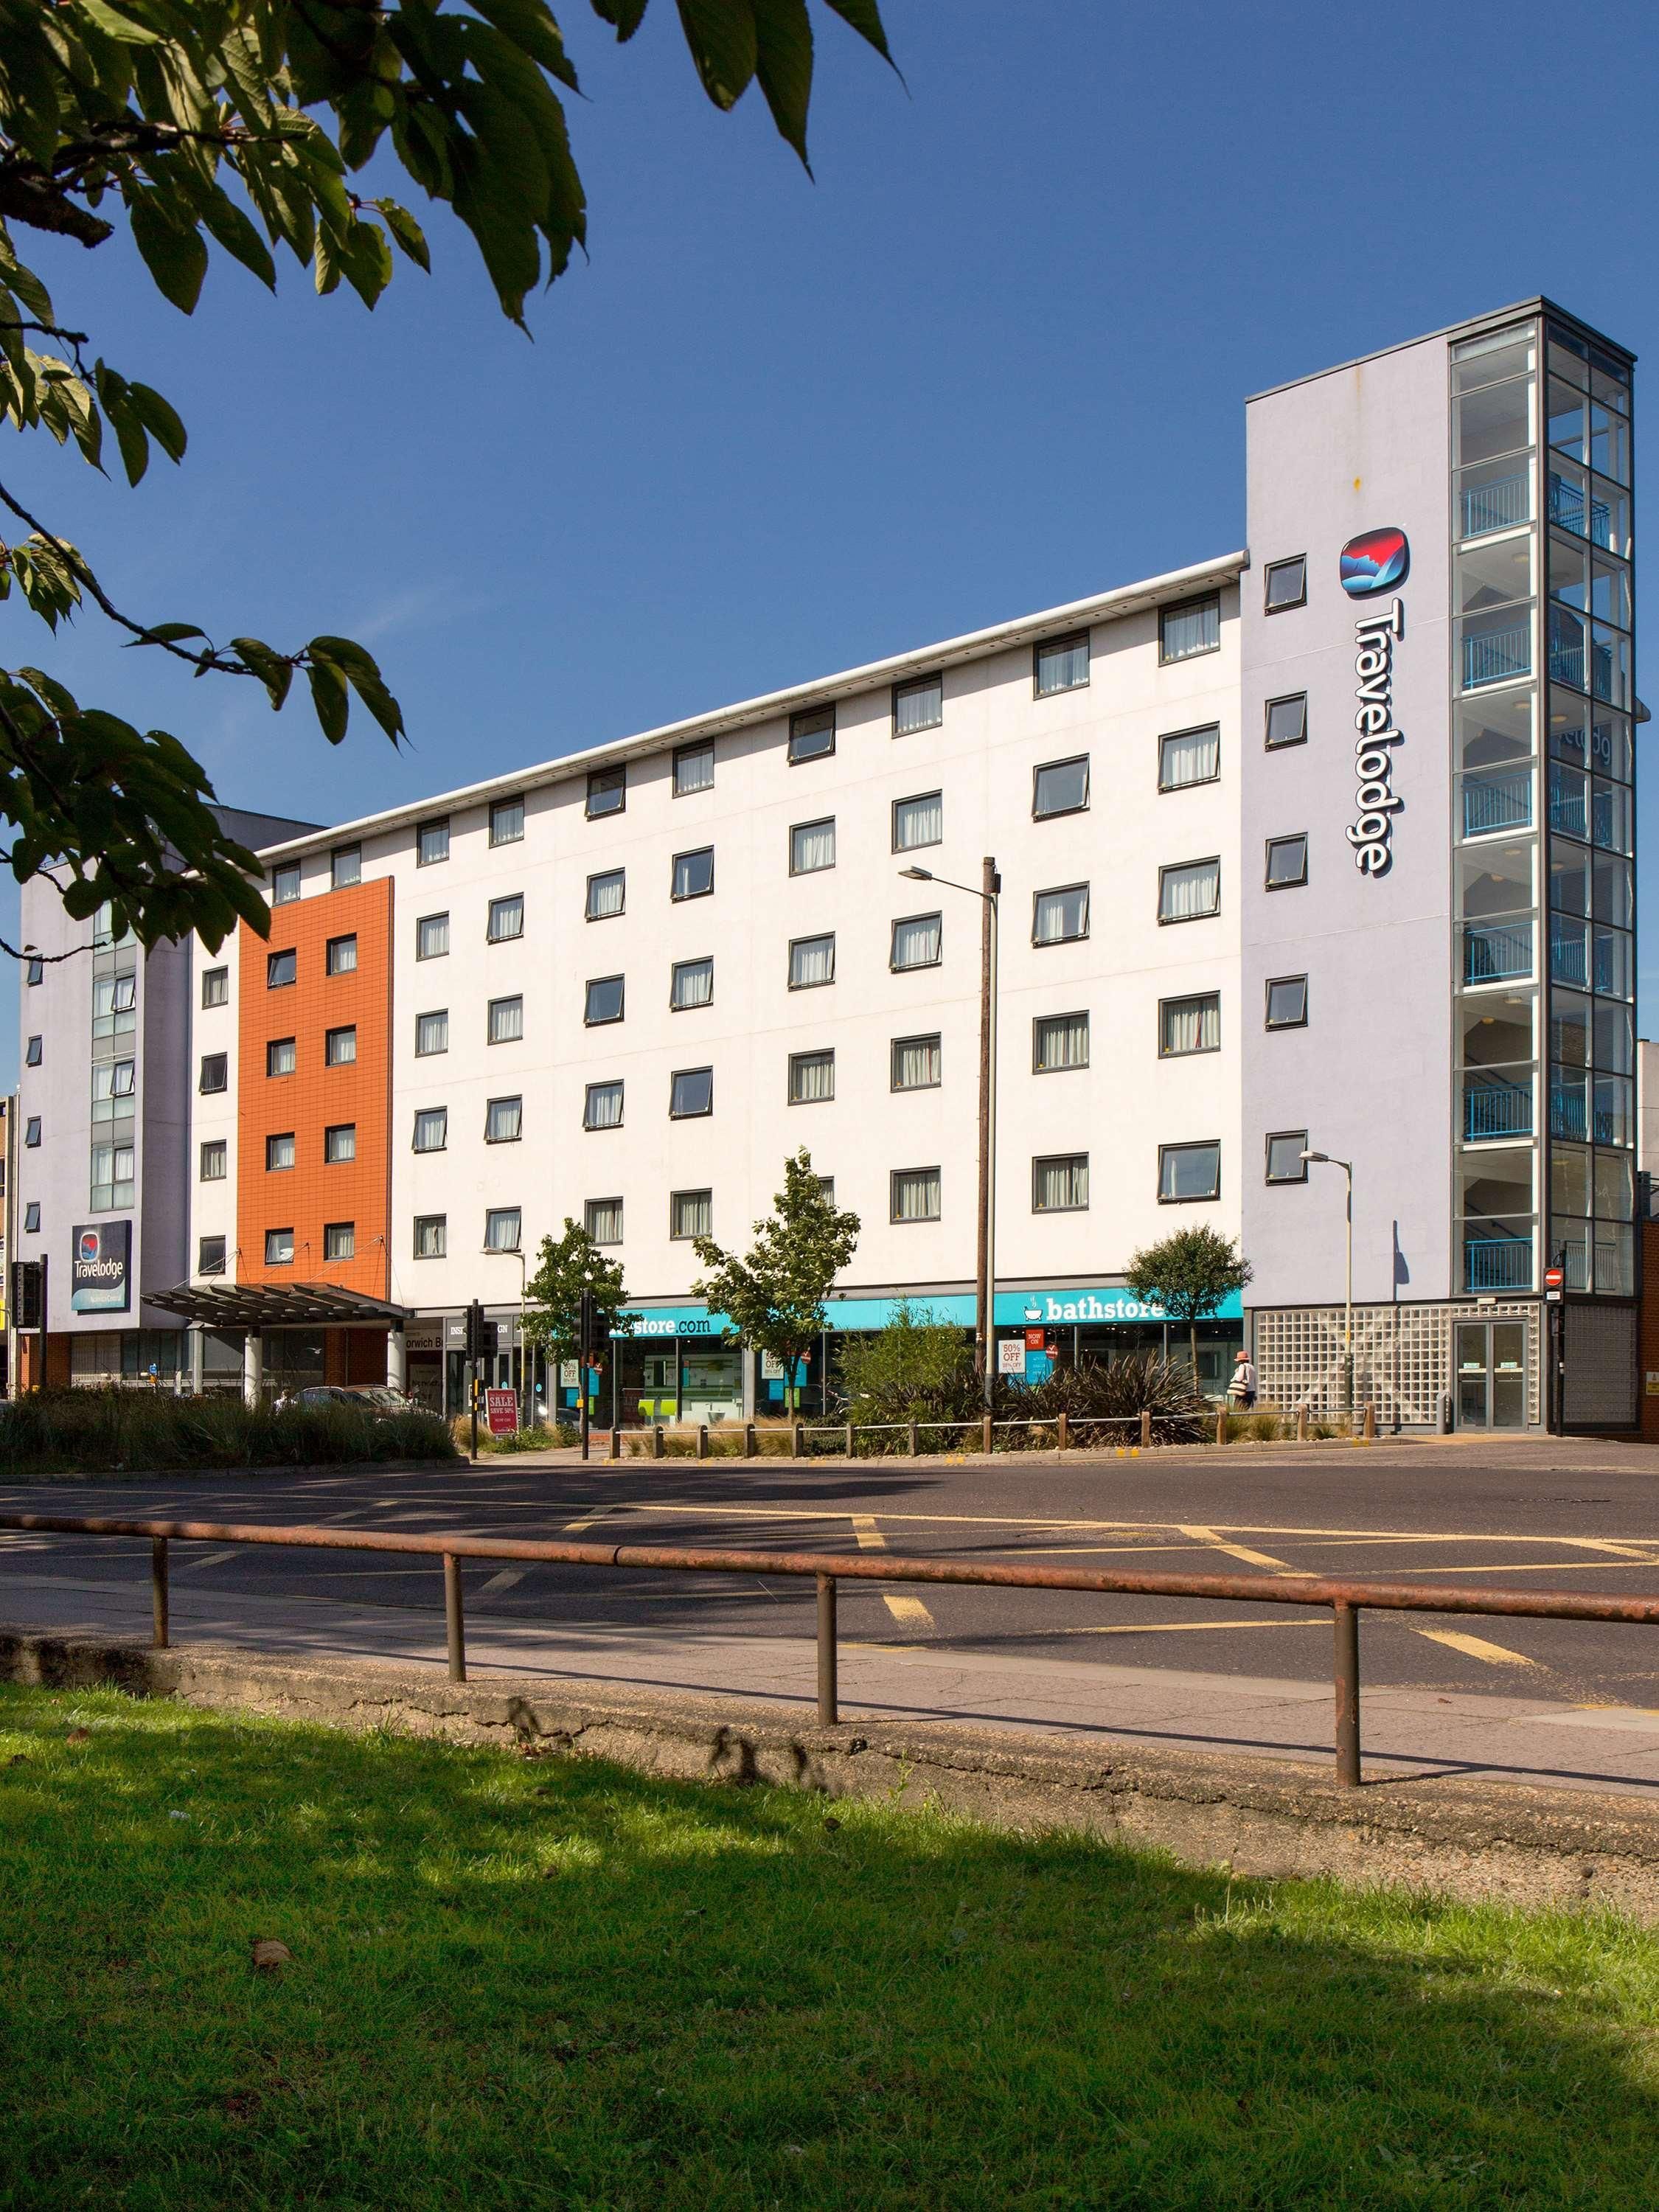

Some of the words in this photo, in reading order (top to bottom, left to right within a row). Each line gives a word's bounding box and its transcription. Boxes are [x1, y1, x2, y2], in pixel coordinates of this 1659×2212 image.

[1346, 597, 1402, 872] Travelodge
[74, 1257, 123, 1279] Travelodge
[406, 1337, 433, 1349] orwich
[1004, 1344, 1020, 1352] 50%
[1004, 1353, 1020, 1361] OFF
[490, 1397, 513, 1407] SALE
